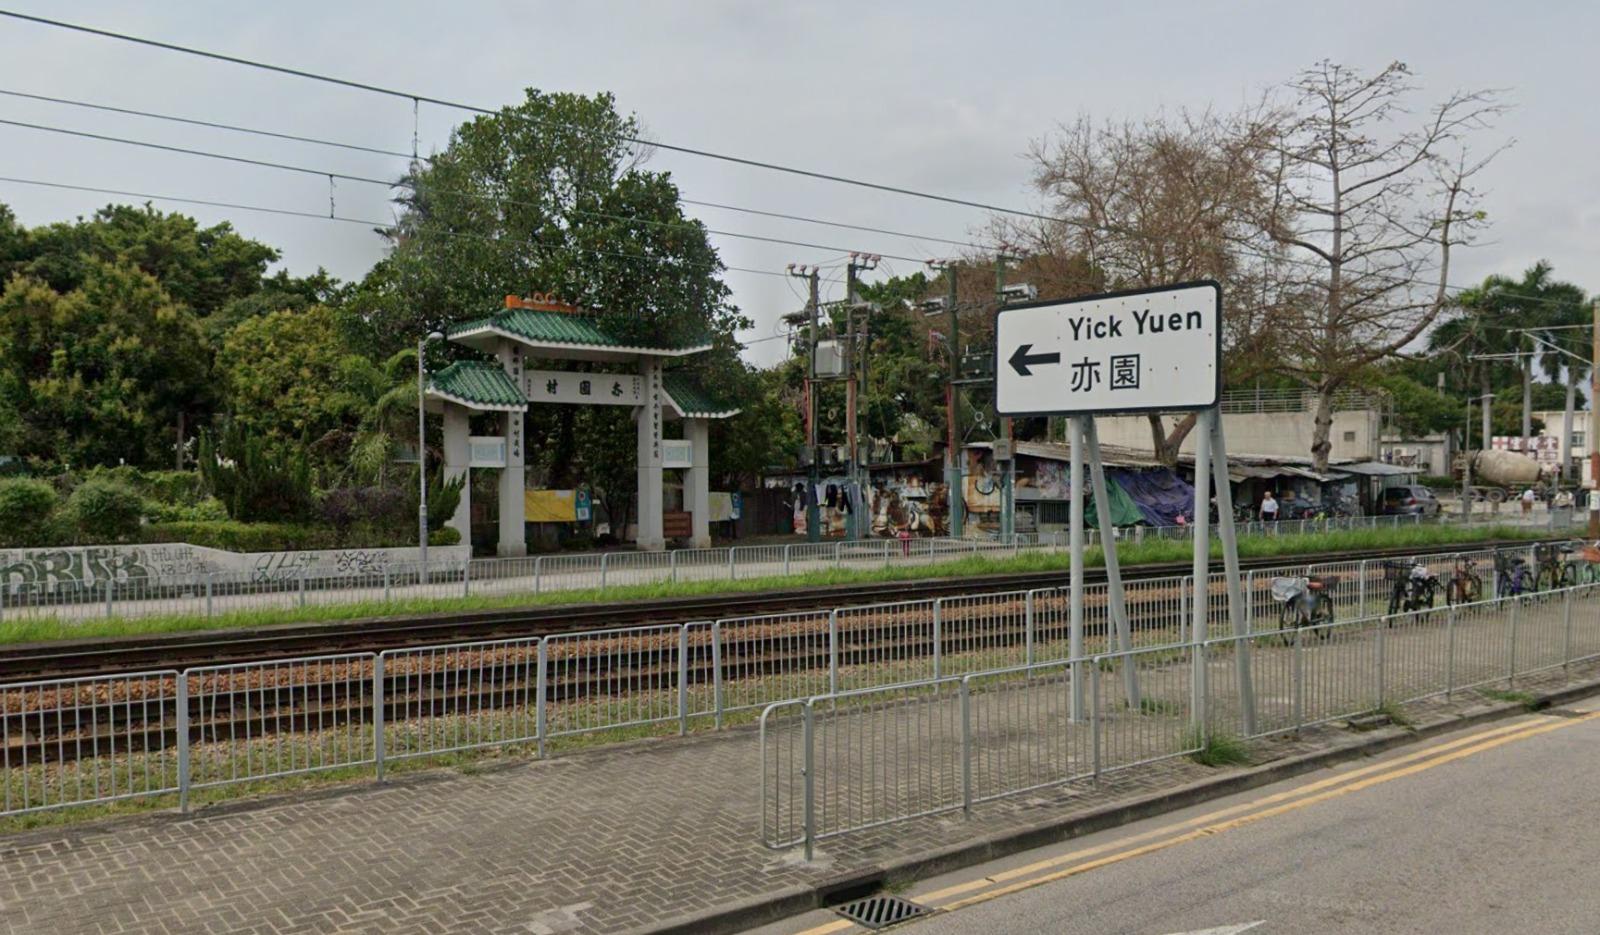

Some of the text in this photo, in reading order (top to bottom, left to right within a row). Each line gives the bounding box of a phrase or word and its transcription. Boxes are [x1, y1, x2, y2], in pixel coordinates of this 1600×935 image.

[1069, 309, 1202, 341] Yick Yuen
[1070, 353, 1141, 393] 亦園
